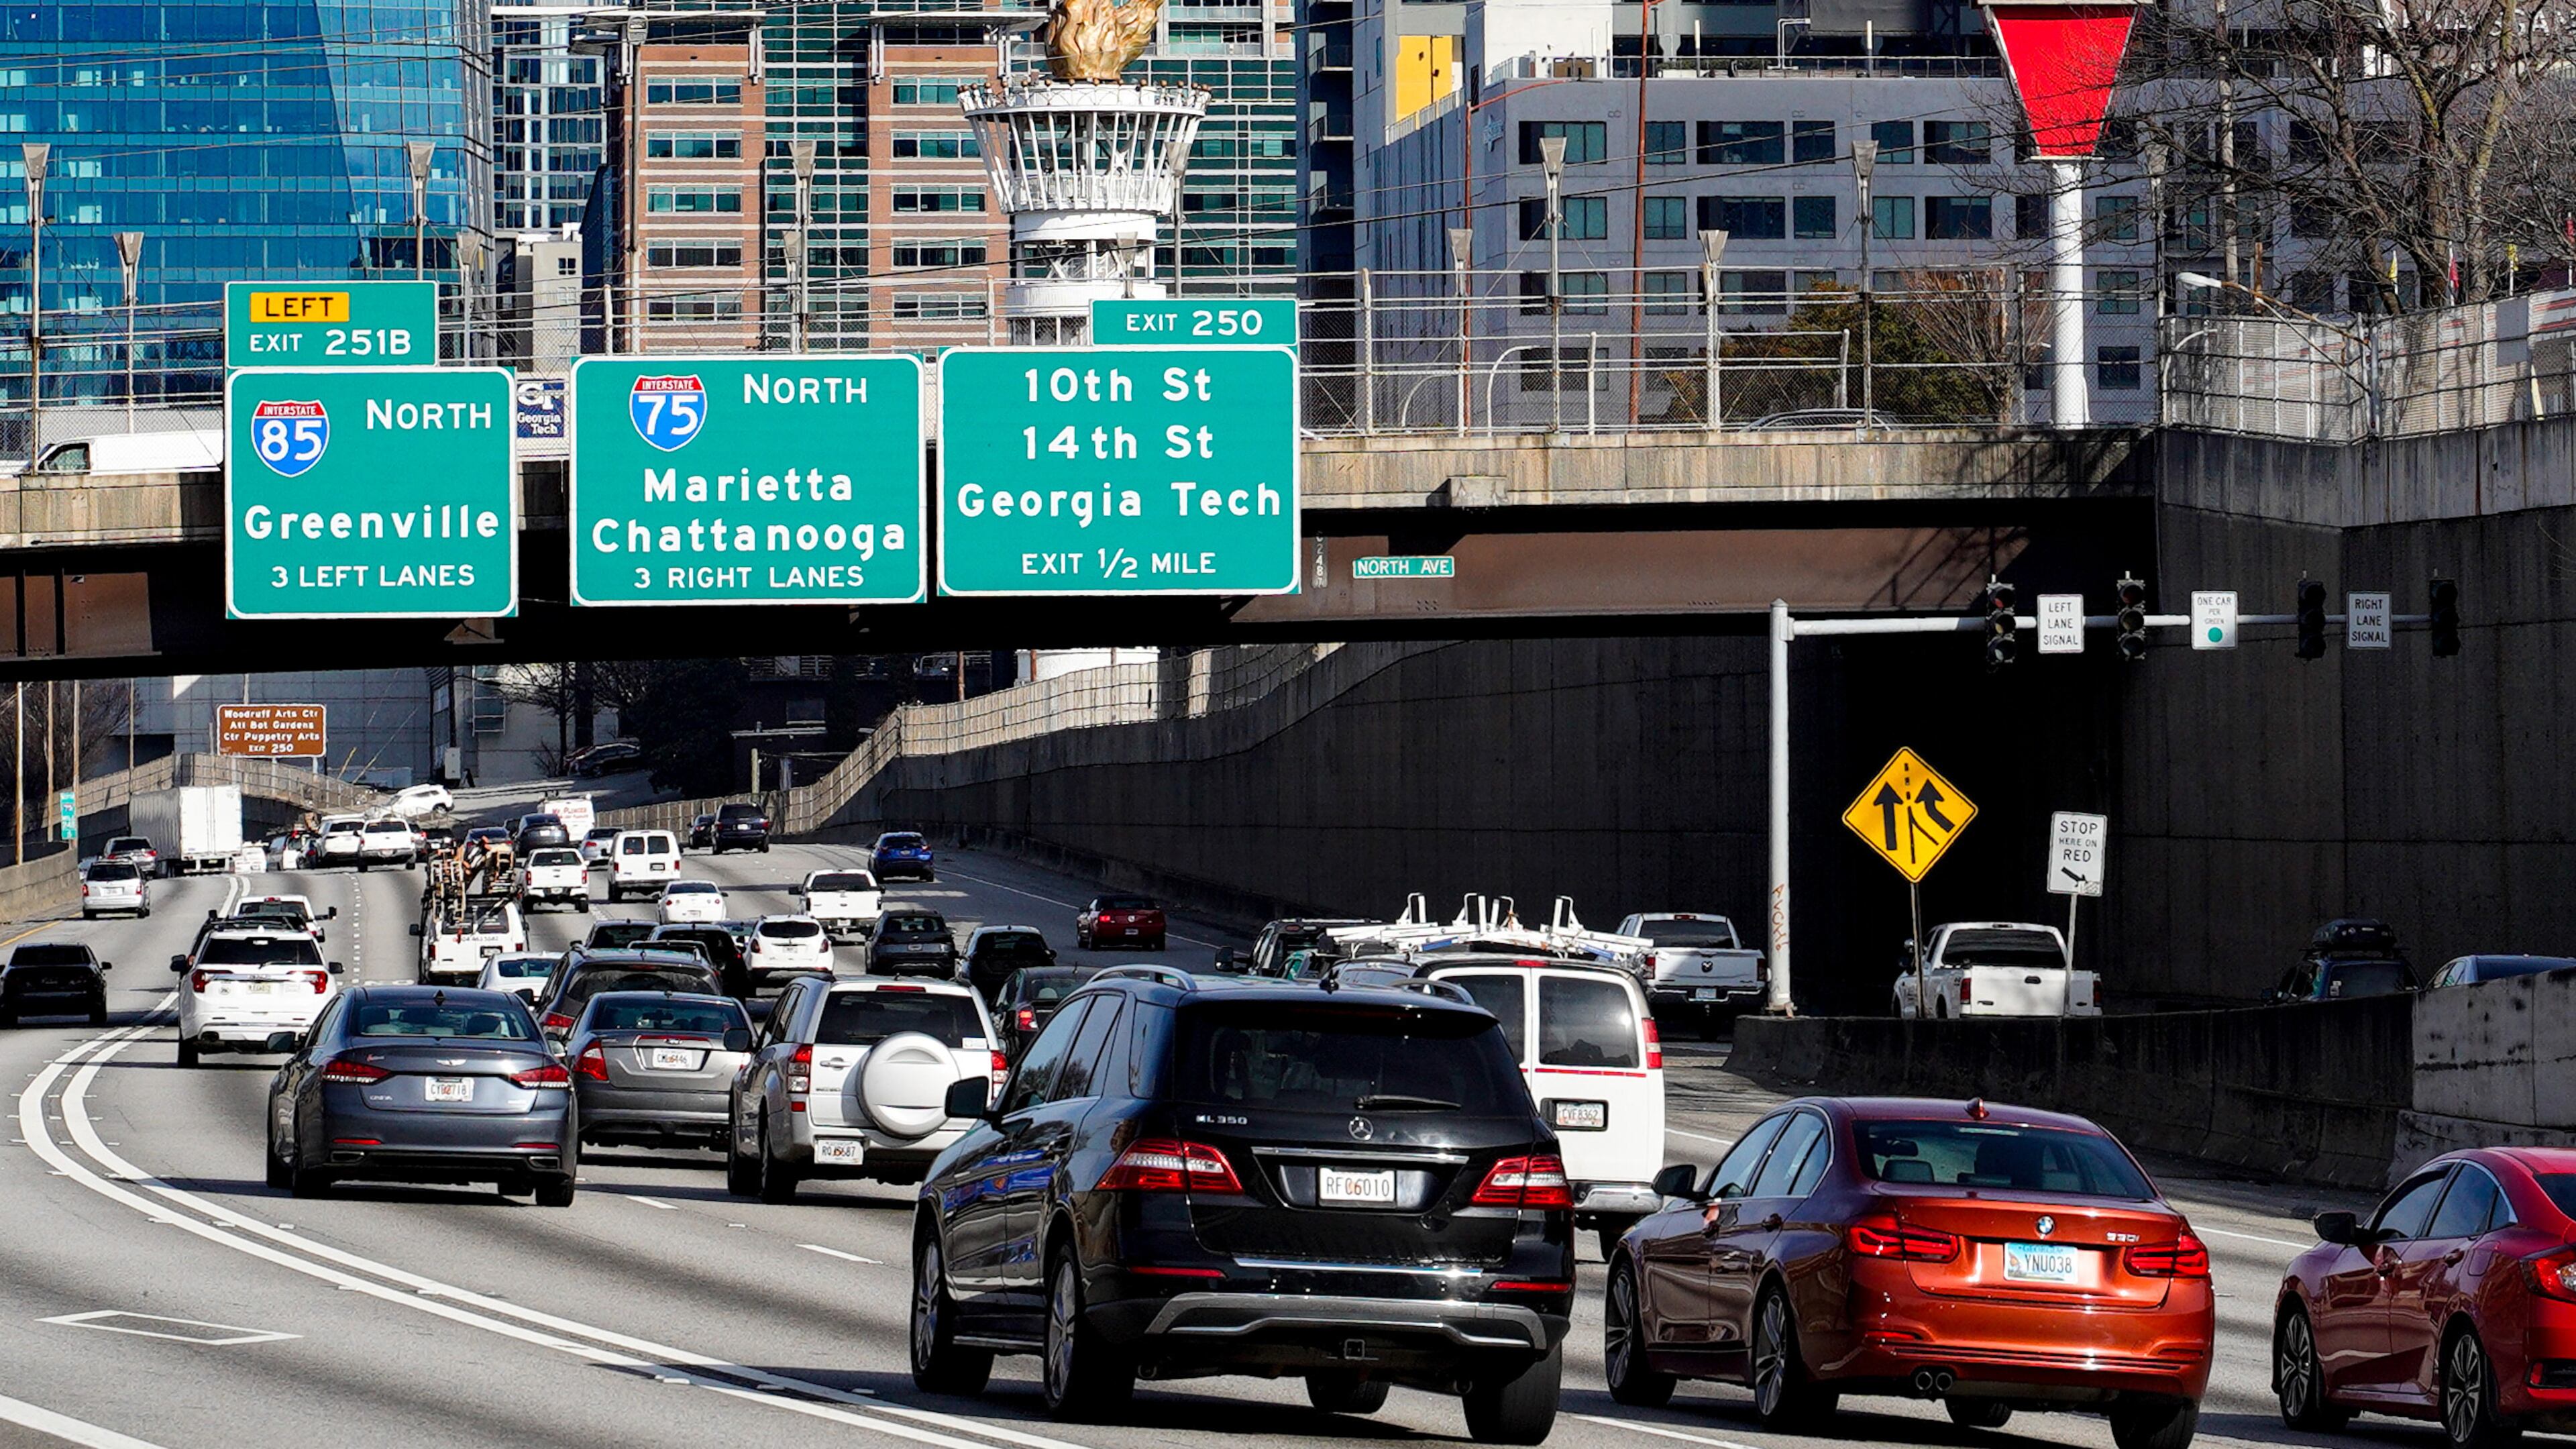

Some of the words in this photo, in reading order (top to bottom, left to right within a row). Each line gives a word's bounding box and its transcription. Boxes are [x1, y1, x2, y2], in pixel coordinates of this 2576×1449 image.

[266, 297, 332, 316] LEFT
[1127, 314, 1177, 331] EXIT
[1193, 310, 1262, 335] 250
[251, 334, 302, 351] EXIT
[326, 330, 410, 355] 251B
[641, 379, 695, 392] INTERSTATE
[1026, 368, 1132, 401] 10th
[1163, 368, 1210, 401] St
[262, 405, 318, 417] INTERSTATE
[517, 411, 561, 425] Georgia
[637, 393, 699, 436] 75
[531, 423, 558, 435] Tech
[258, 420, 323, 463] 85
[1024, 426, 1136, 459] 14th
[1166, 425, 1212, 458] St
[645, 468, 851, 502] Marietta
[958, 483, 1140, 527] Georgia
[1171, 482, 1279, 515] Tech
[245, 505, 498, 539] Greenville
[593, 519, 904, 561] Chattanooga
[1022, 553, 1082, 574] EXIT
[1152, 553, 1215, 573] MILE
[1358, 561, 1409, 574] NORTH
[1420, 559, 1449, 574] AVE
[272, 567, 287, 587] 3
[300, 566, 368, 586] LEFT
[380, 565, 474, 586] LANES
[635, 568, 650, 588] 3
[669, 568, 751, 588] RIGHT
[769, 566, 863, 587] LANES
[2049, 602, 2072, 612] LEFT
[2197, 596, 2213, 606] ONE
[2215, 596, 2232, 606] CAR
[2355, 598, 2383, 610] RIGHT
[2048, 619, 2073, 629] LANE
[2357, 615, 2382, 626] LANE
[2043, 635, 2078, 645] SIGNAL
[2351, 631, 2387, 642] SIGNAL
[224, 709, 271, 718] Woodruff
[275, 710, 297, 718] Arts
[272, 720, 314, 729] Gardens
[244, 732, 292, 743] Puppetry
[297, 733, 320, 741] Arts
[271, 743, 294, 753] 250
[2060, 820, 2098, 835] STOP
[2063, 849, 2091, 863] RED
[1217, 1116, 1248, 1124] 350
[2025, 1254, 2072, 1273] YNU038
